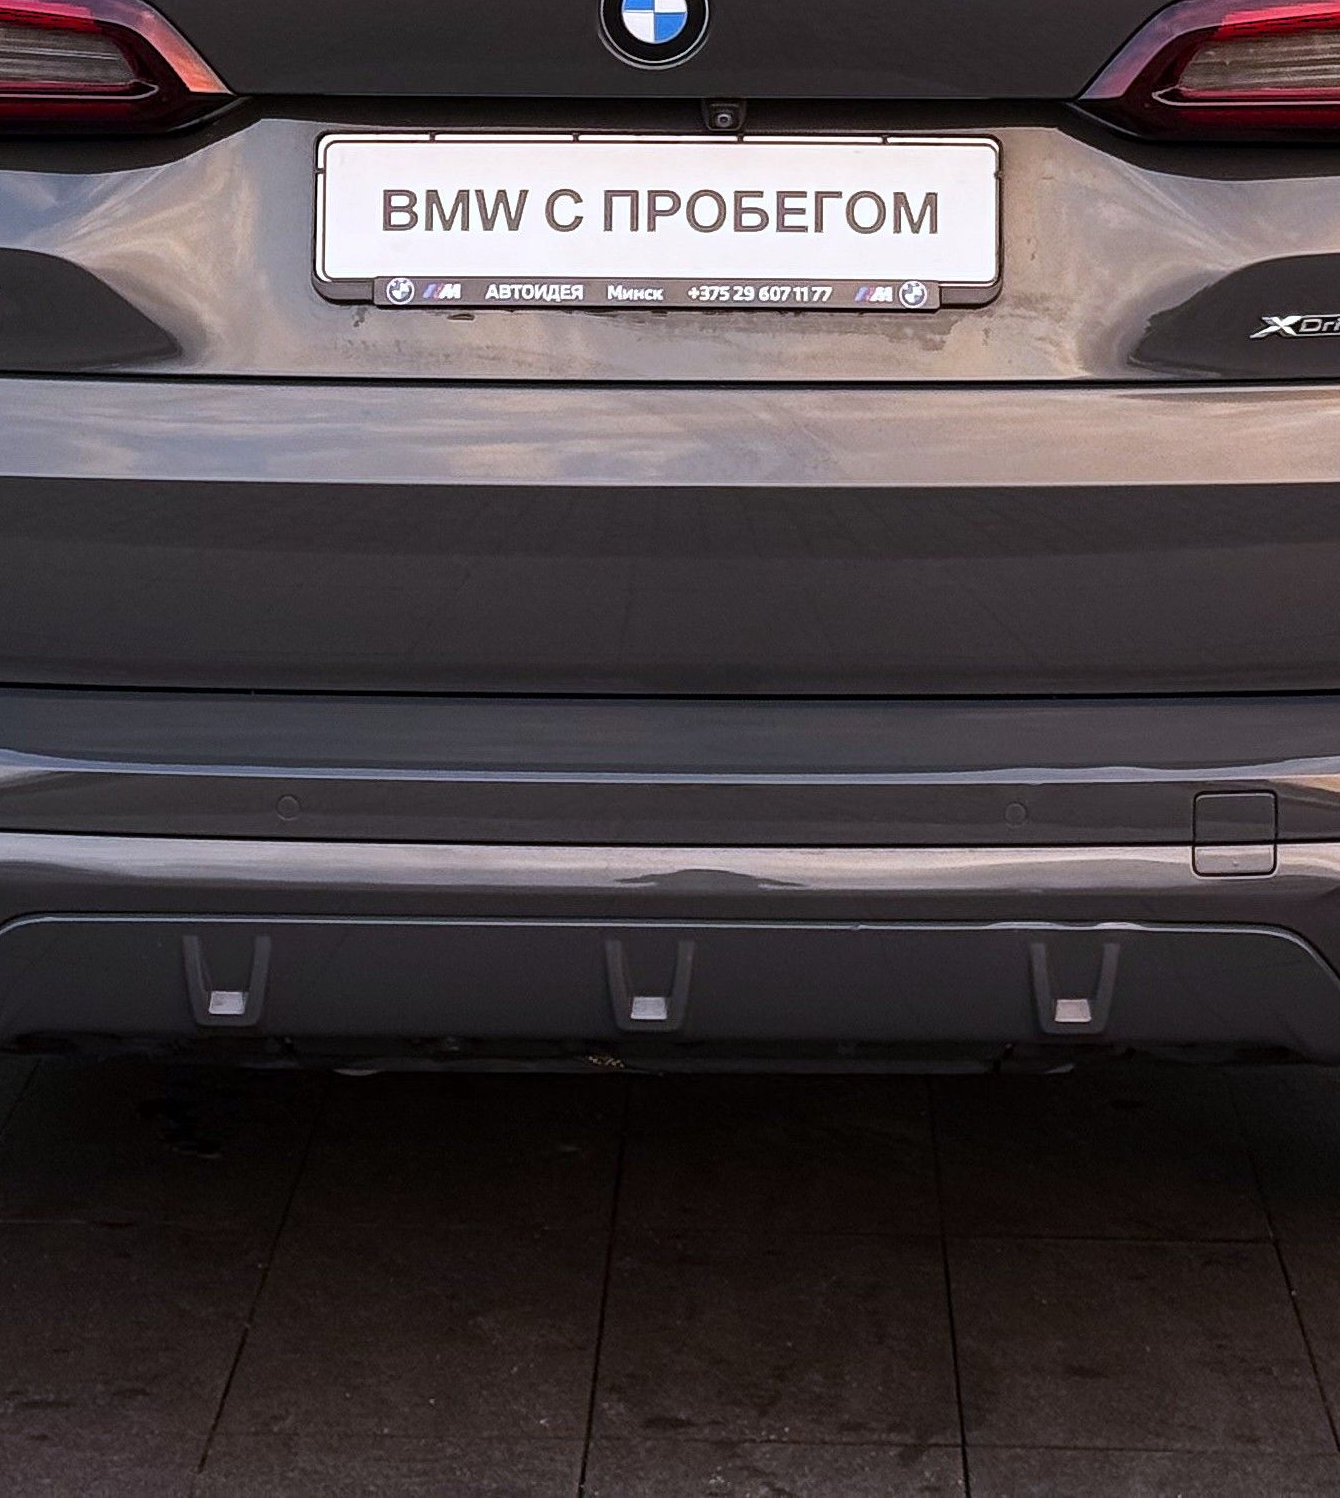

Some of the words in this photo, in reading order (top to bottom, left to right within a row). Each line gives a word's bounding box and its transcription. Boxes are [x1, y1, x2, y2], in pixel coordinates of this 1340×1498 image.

[382, 189, 529, 232] BMW
[603, 189, 938, 234] ПРОБЕГОМ
[485, 284, 584, 302] АВТОИДЕЯ
[607, 285, 663, 301] Минск
